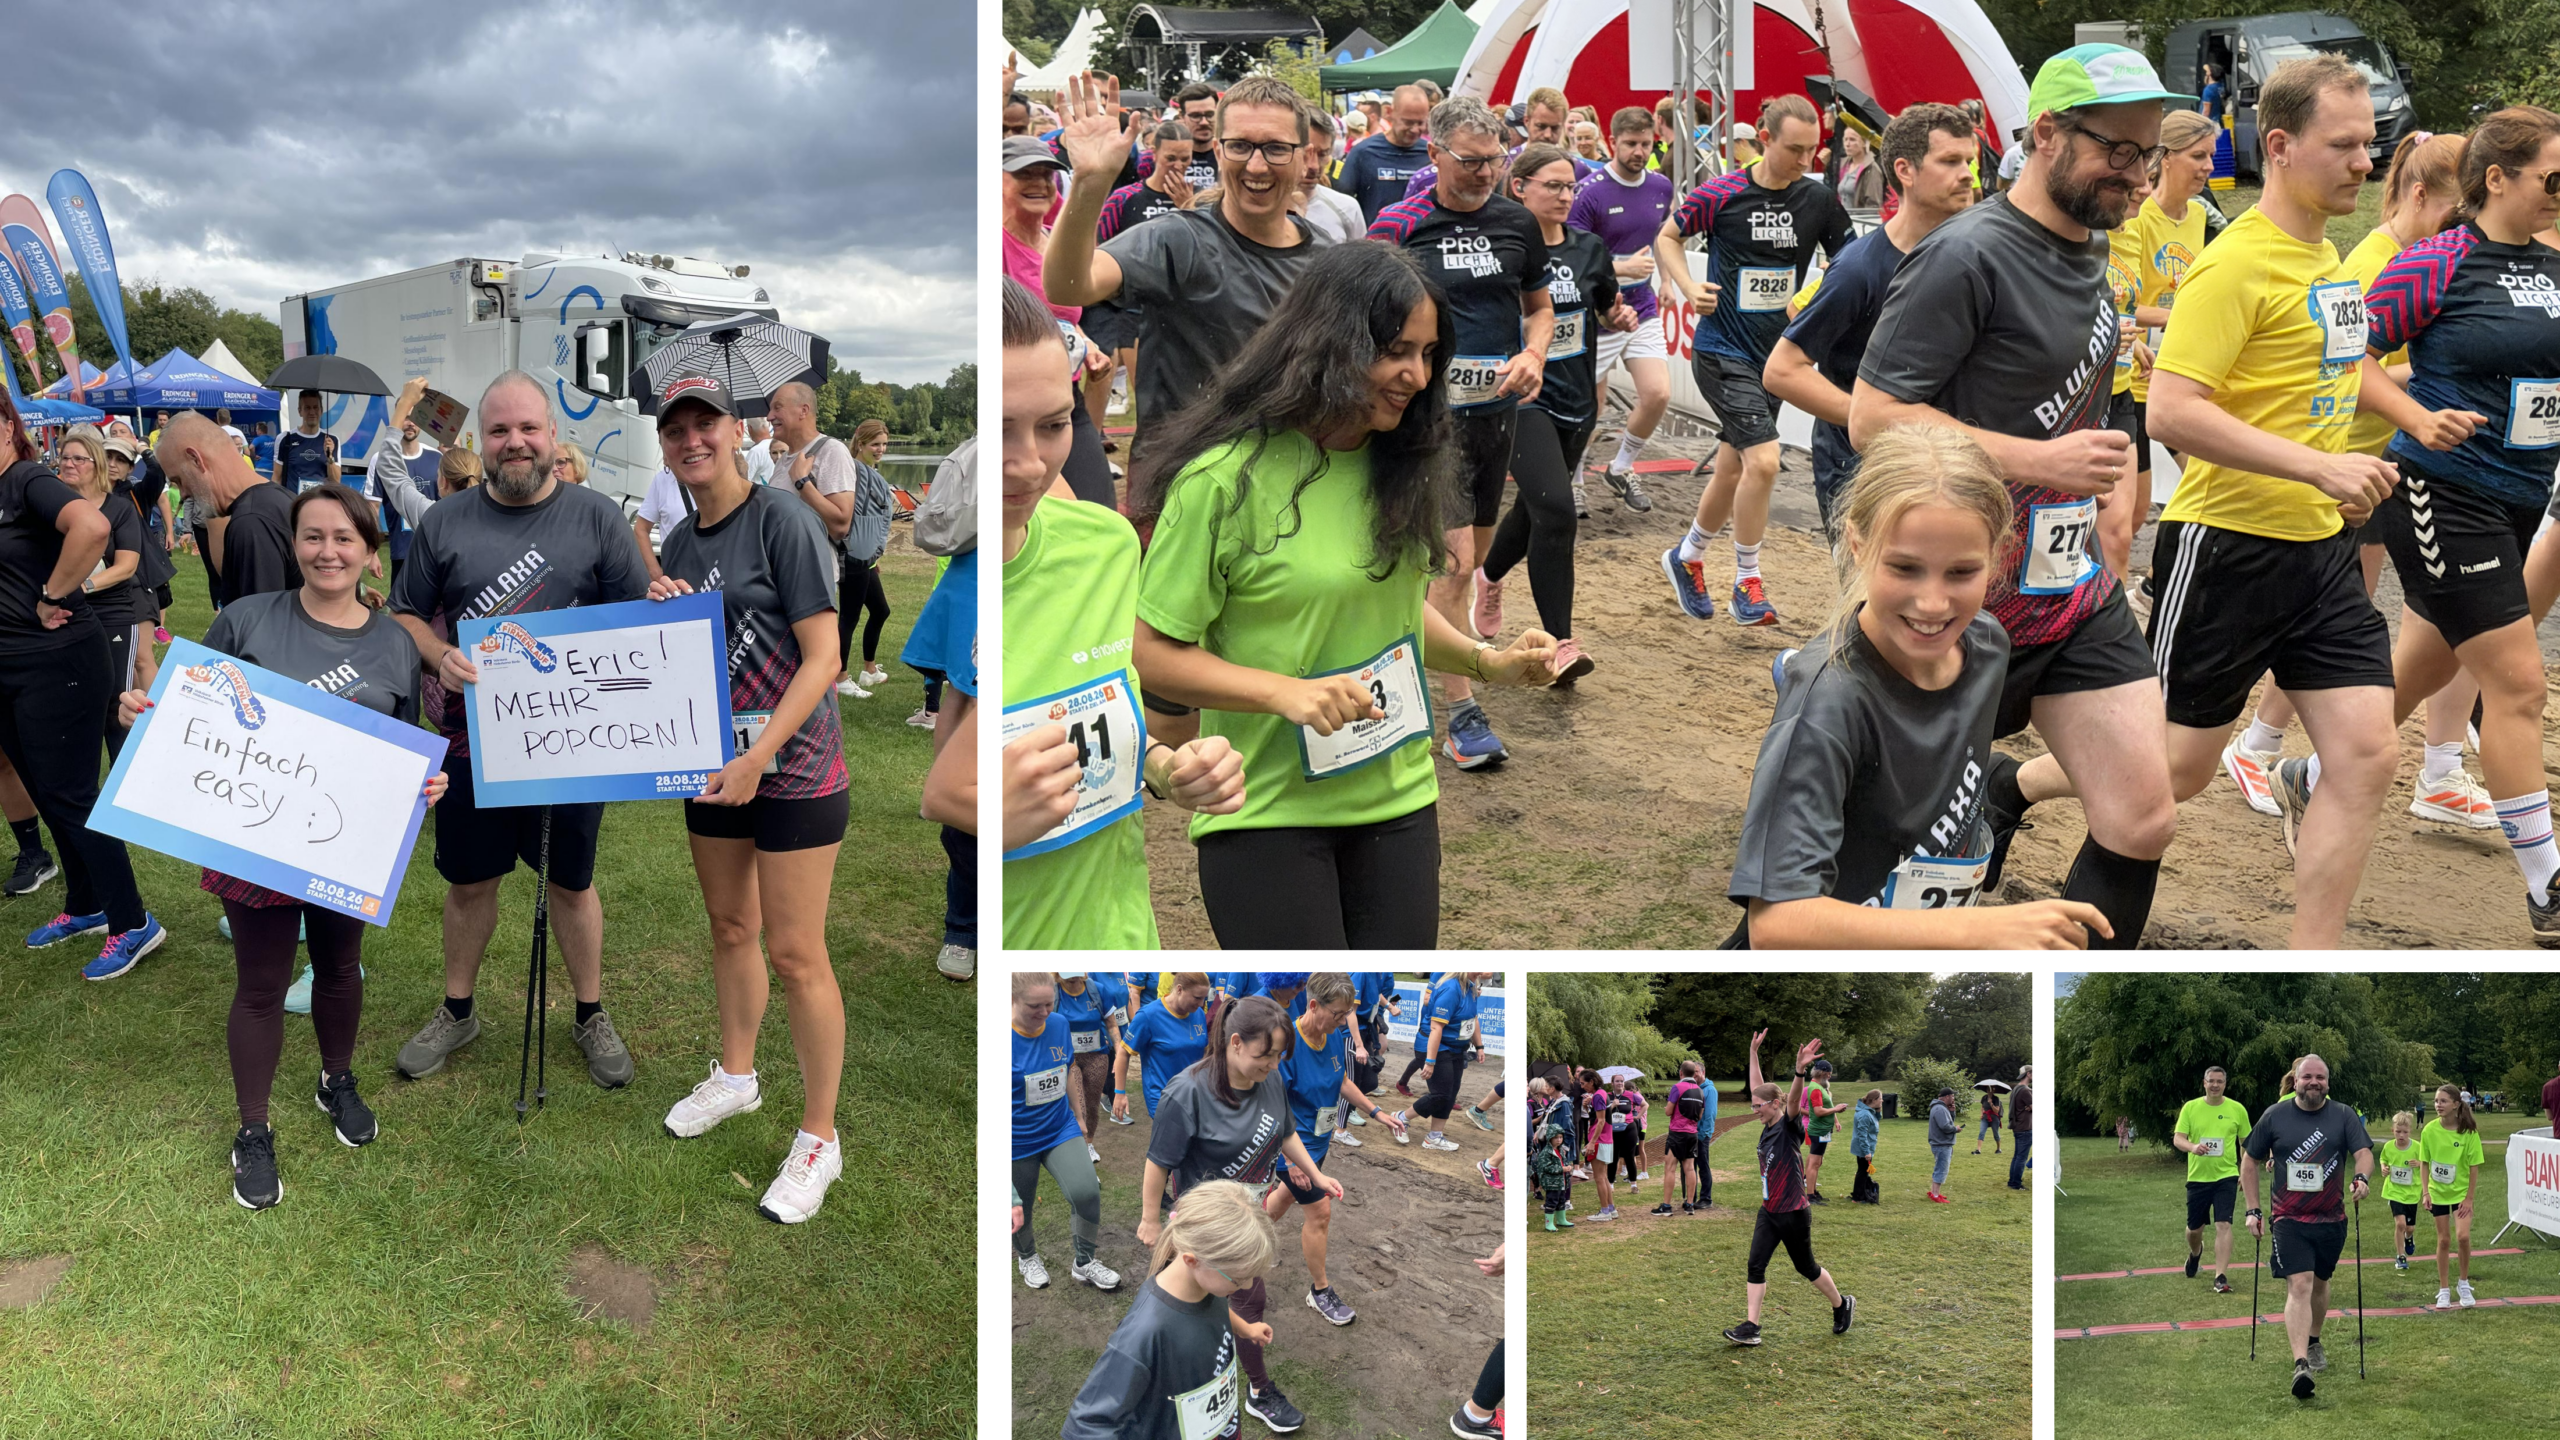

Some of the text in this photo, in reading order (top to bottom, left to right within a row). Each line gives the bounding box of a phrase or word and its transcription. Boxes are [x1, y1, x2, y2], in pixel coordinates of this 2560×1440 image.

[1747, 211, 1793, 227] PRO
[1754, 229, 1791, 239] LICHT
[1437, 236, 1491, 253] PRO
[1446, 254, 1492, 267] LICHT
[1749, 278, 1788, 293] 2828
[2496, 273, 2555, 290] PRO
[2331, 300, 2364, 327] 2832
[2033, 299, 2114, 431] BLULAXA
[168, 372, 210, 380] ERDINGER
[1450, 368, 1496, 386] 2819
[161, 389, 191, 398] ERDINGER
[224, 391, 251, 400] ERDINGER
[2459, 556, 2501, 575] hummel
[530, 564, 554, 587] Lighting
[484, 637, 496, 647] 10
[502, 625, 550, 665] FIRMENLAUF
[729, 629, 756, 683] ume
[193, 666, 208, 678] 10
[220, 664, 256, 720] FIRMENLAUF
[1067, 688, 1104, 709] 28.08.26
[495, 687, 599, 721] MEHR
[1052, 704, 1063, 715] 10
[1069, 706, 1085, 716] START
[184, 717, 317, 787] Einfach
[655, 773, 708, 786] 28.08.26
[193, 770, 284, 828] easy
[308, 877, 364, 905] 28.08.26
[306, 888, 327, 900] START
[332, 897, 347, 907] ZIEL
[348, 903, 360, 912] AM
[1077, 1036, 1094, 1045] 532
[1038, 1076, 1059, 1090] 529
[1222, 1113, 1275, 1178] BLULAXA
[2295, 1169, 2315, 1180] 456
[2395, 1170, 2408, 1178] 427
[2434, 1166, 2449, 1176] 426
